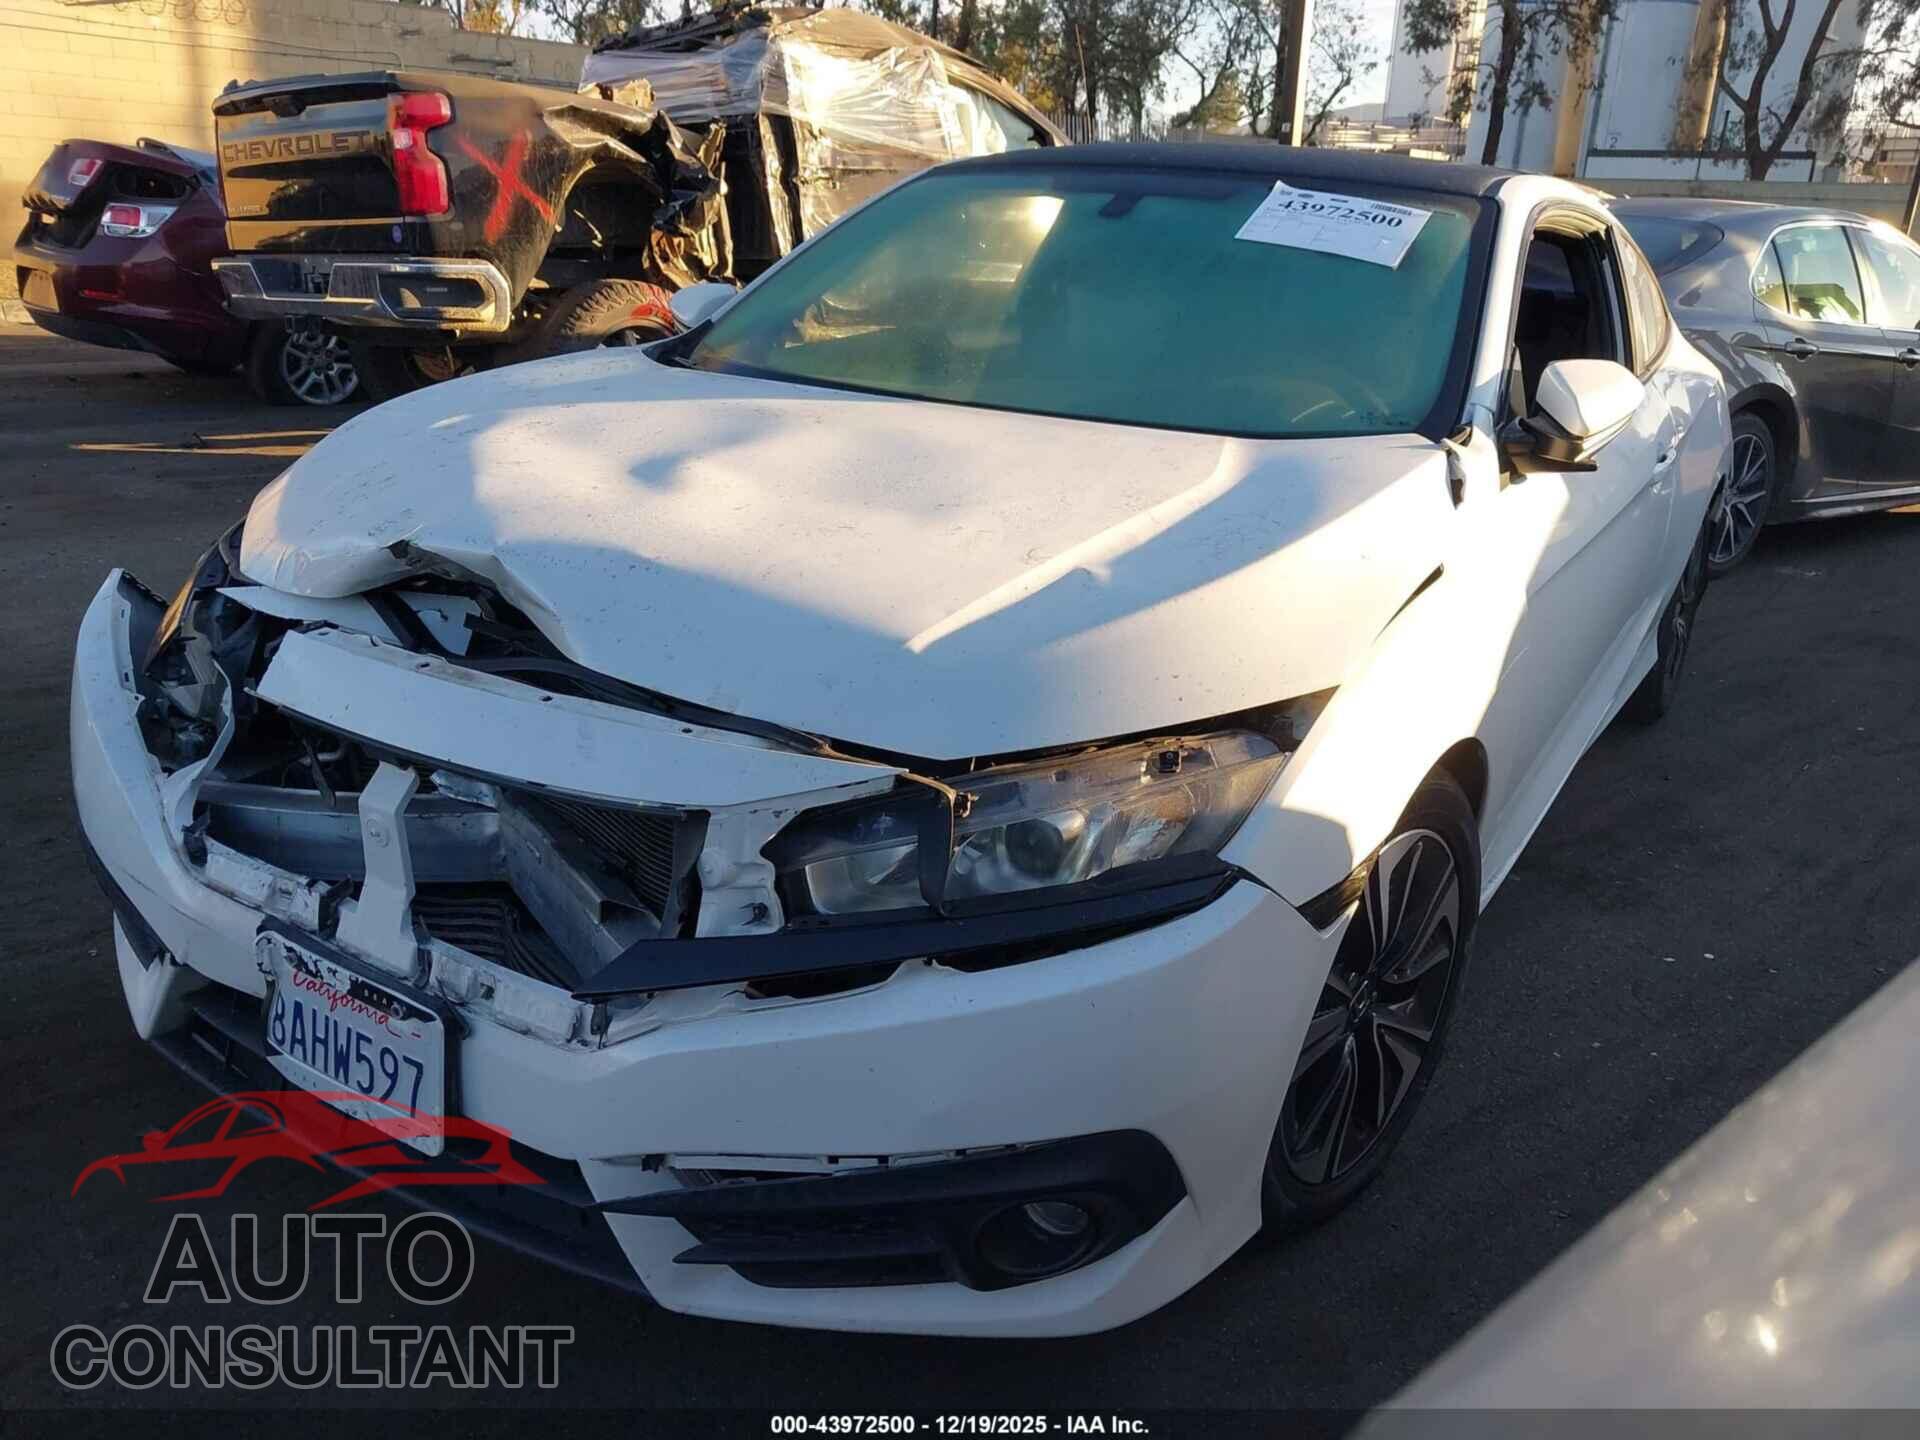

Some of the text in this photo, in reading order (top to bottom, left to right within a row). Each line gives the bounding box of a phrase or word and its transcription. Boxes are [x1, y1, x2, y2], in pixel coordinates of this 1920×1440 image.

[223, 130, 371, 162] CHEVROLET
[1278, 199, 1403, 228] 43972500
[271, 991, 424, 1119] 8AHW597
